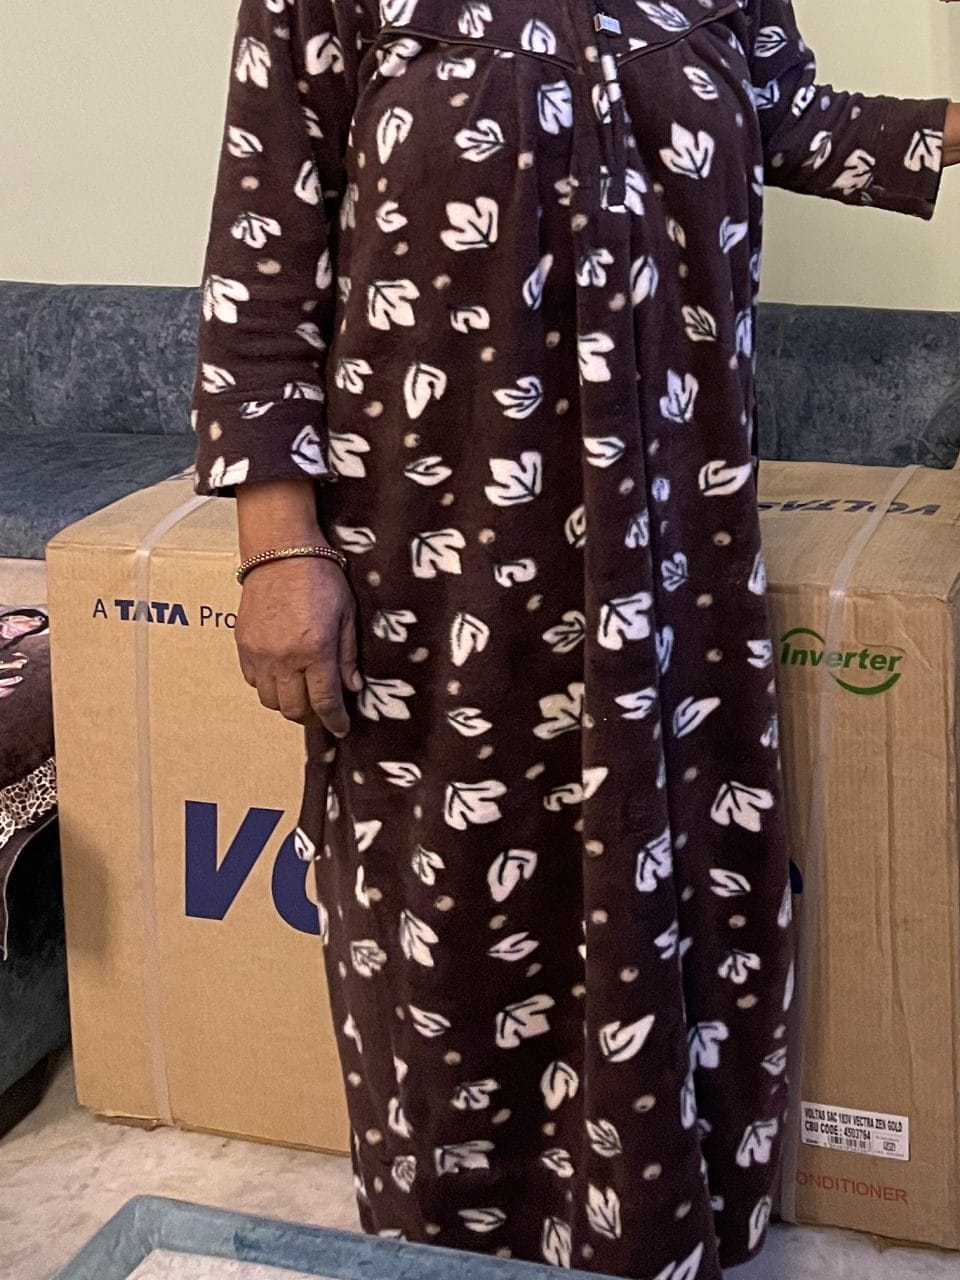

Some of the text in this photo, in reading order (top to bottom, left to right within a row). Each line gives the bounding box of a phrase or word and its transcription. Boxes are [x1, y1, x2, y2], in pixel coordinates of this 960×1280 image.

[93, 599, 108, 619] A
[114, 599, 190, 626] TATA
[780, 642, 903, 672] Inverter
[796, 1170, 909, 1203] ONDITIONER
